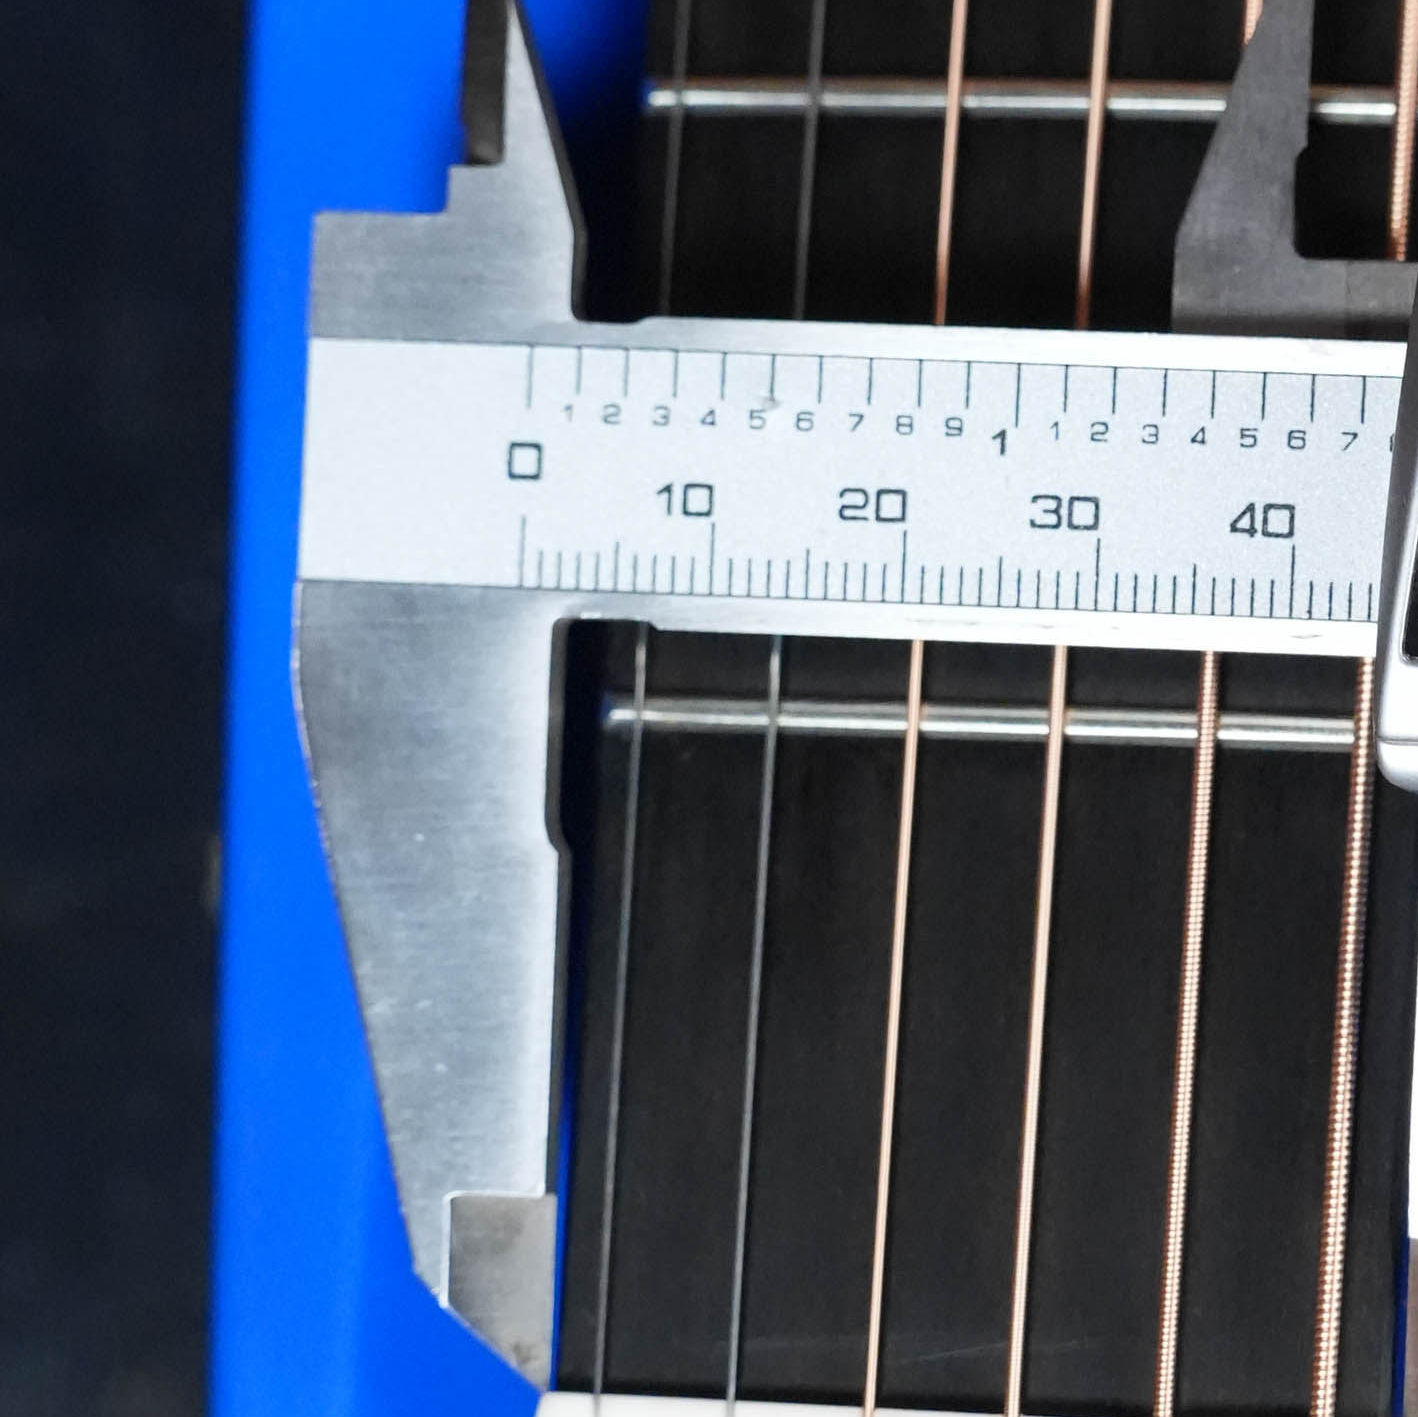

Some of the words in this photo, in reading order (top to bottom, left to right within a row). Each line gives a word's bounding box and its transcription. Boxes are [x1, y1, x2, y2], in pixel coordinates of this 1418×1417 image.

[561, 403, 575, 423] 1
[601, 403, 622, 425] 2
[652, 405, 671, 427] 3
[698, 407, 718, 428] 4
[748, 408, 767, 431] 5
[795, 411, 814, 432] 6
[848, 413, 865, 431] 7
[895, 414, 914, 436] 8
[944, 416, 964, 437] 9
[991, 429, 1007, 456] 1
[1049, 421, 1059, 441] 1
[1090, 421, 1109, 443] 2
[1141, 423, 1160, 445] 3
[1190, 426, 1206, 445] 4
[1239, 427, 1259, 449] 5
[1287, 429, 1307, 450] 6
[1341, 431, 1359, 451] 7
[507, 441, 543, 481] 0
[656, 482, 714, 518] 10
[838, 487, 908, 523] 20
[1029, 494, 1100, 531] 30
[1229, 502, 1296, 539] 40
